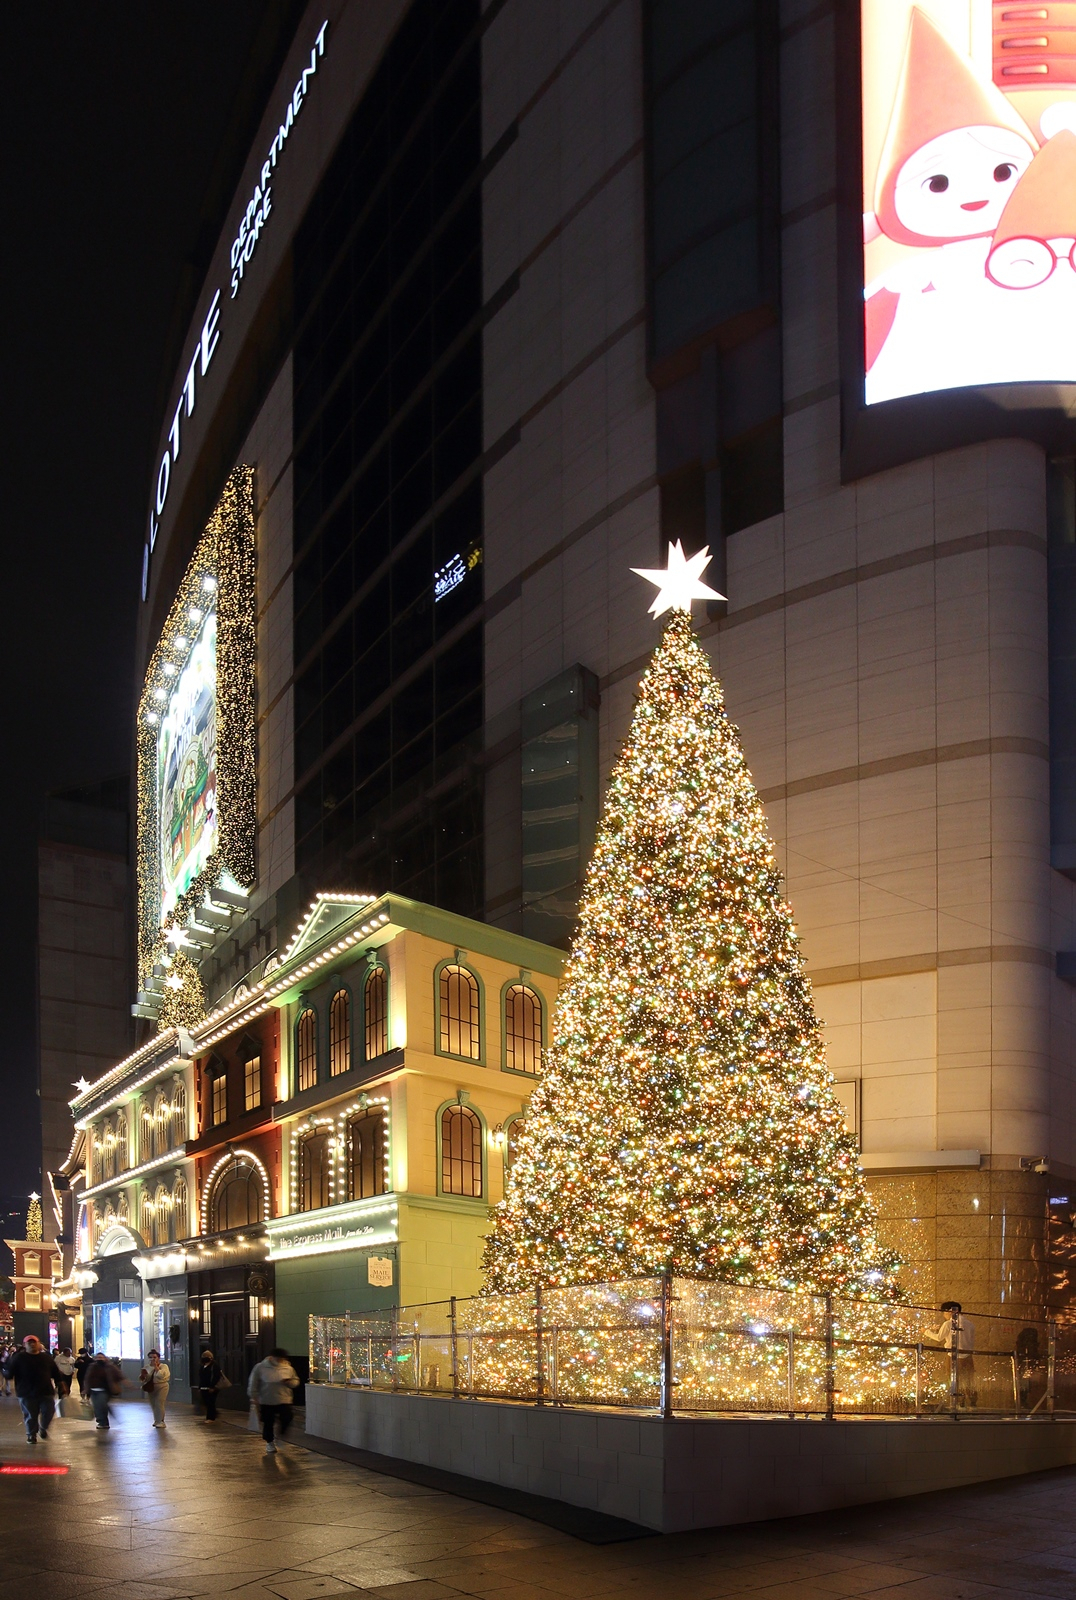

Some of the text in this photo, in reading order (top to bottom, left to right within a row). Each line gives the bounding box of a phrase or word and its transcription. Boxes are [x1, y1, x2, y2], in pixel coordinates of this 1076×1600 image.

[230, 19, 329, 270] DEPARTMENT
[230, 187, 272, 299] STORE
[150, 289, 221, 554] LOTTE
[293, 1234, 323, 1248] Express
